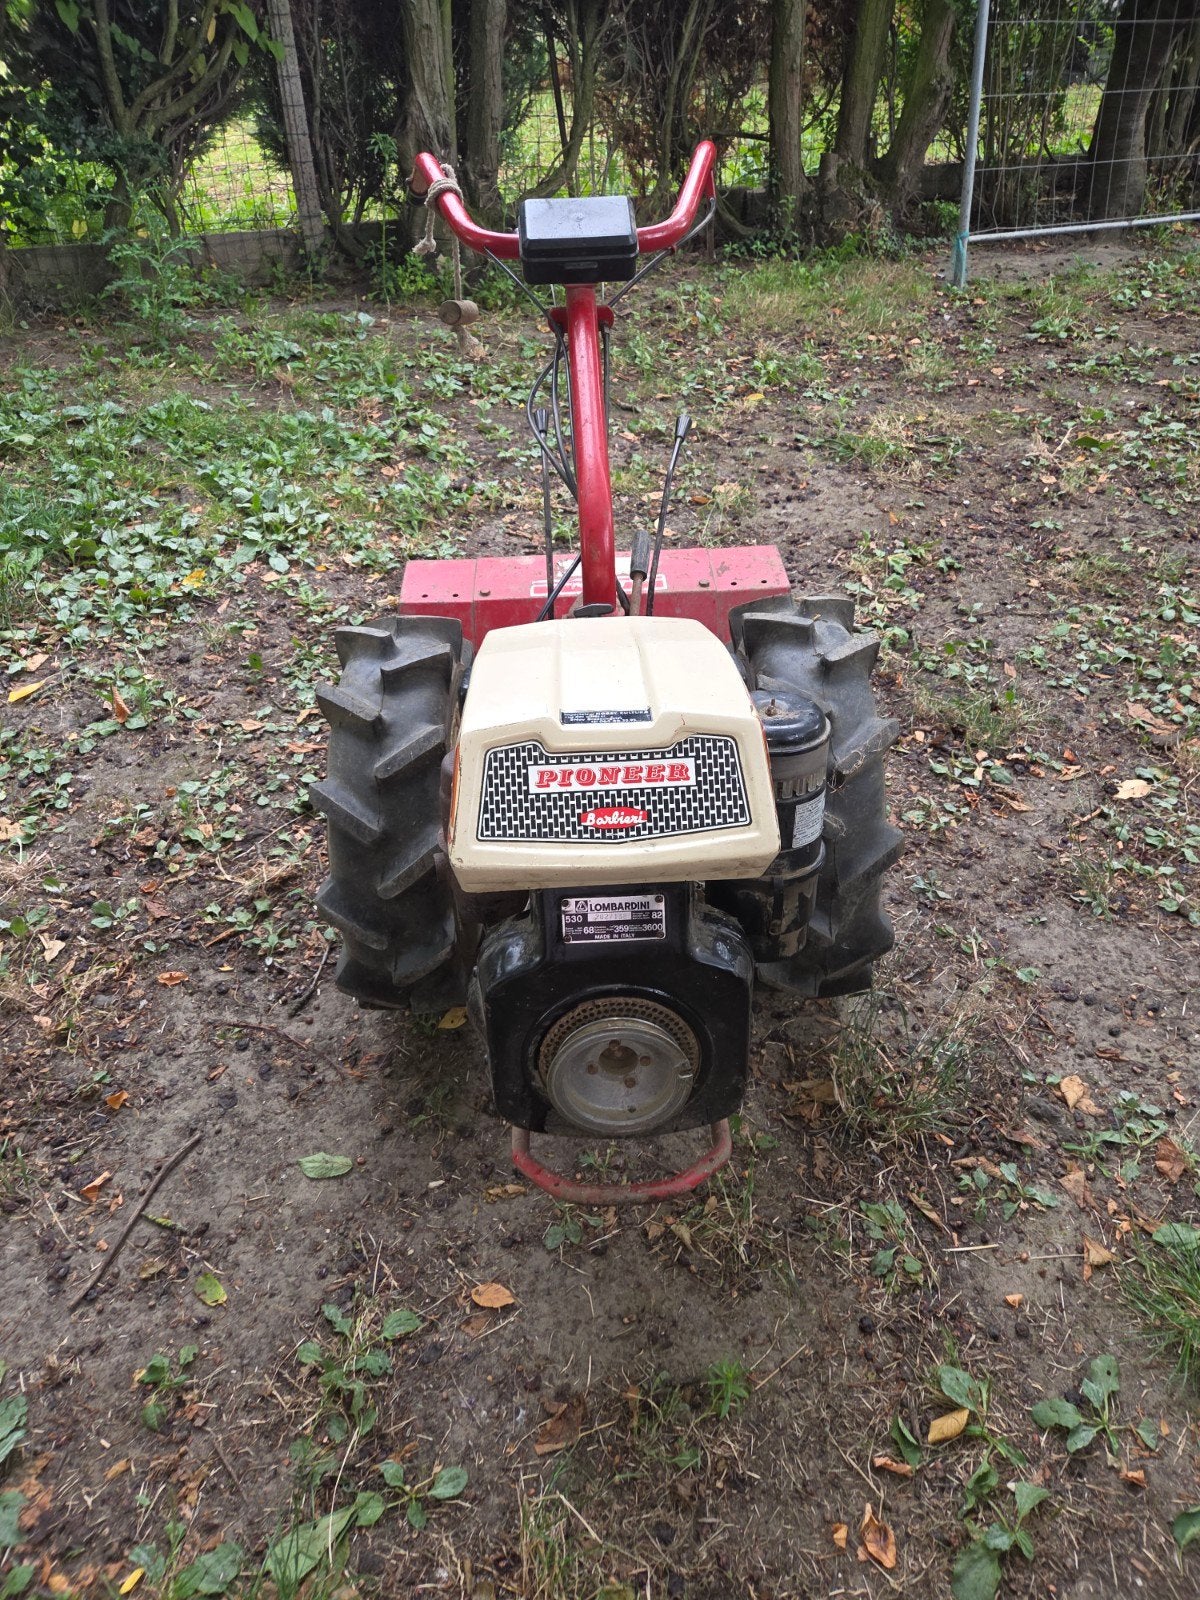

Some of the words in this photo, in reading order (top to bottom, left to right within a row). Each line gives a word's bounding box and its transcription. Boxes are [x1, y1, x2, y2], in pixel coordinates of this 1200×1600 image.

[535, 762, 691, 789] PIONEER
[583, 811, 645, 826] Barbieri
[589, 901, 650, 912] LOMBARDINI
[565, 914, 583, 924] 530
[651, 911, 663, 919] 82
[583, 926, 595, 935] 68
[613, 924, 629, 933] 359
[642, 923, 663, 931] 3600
